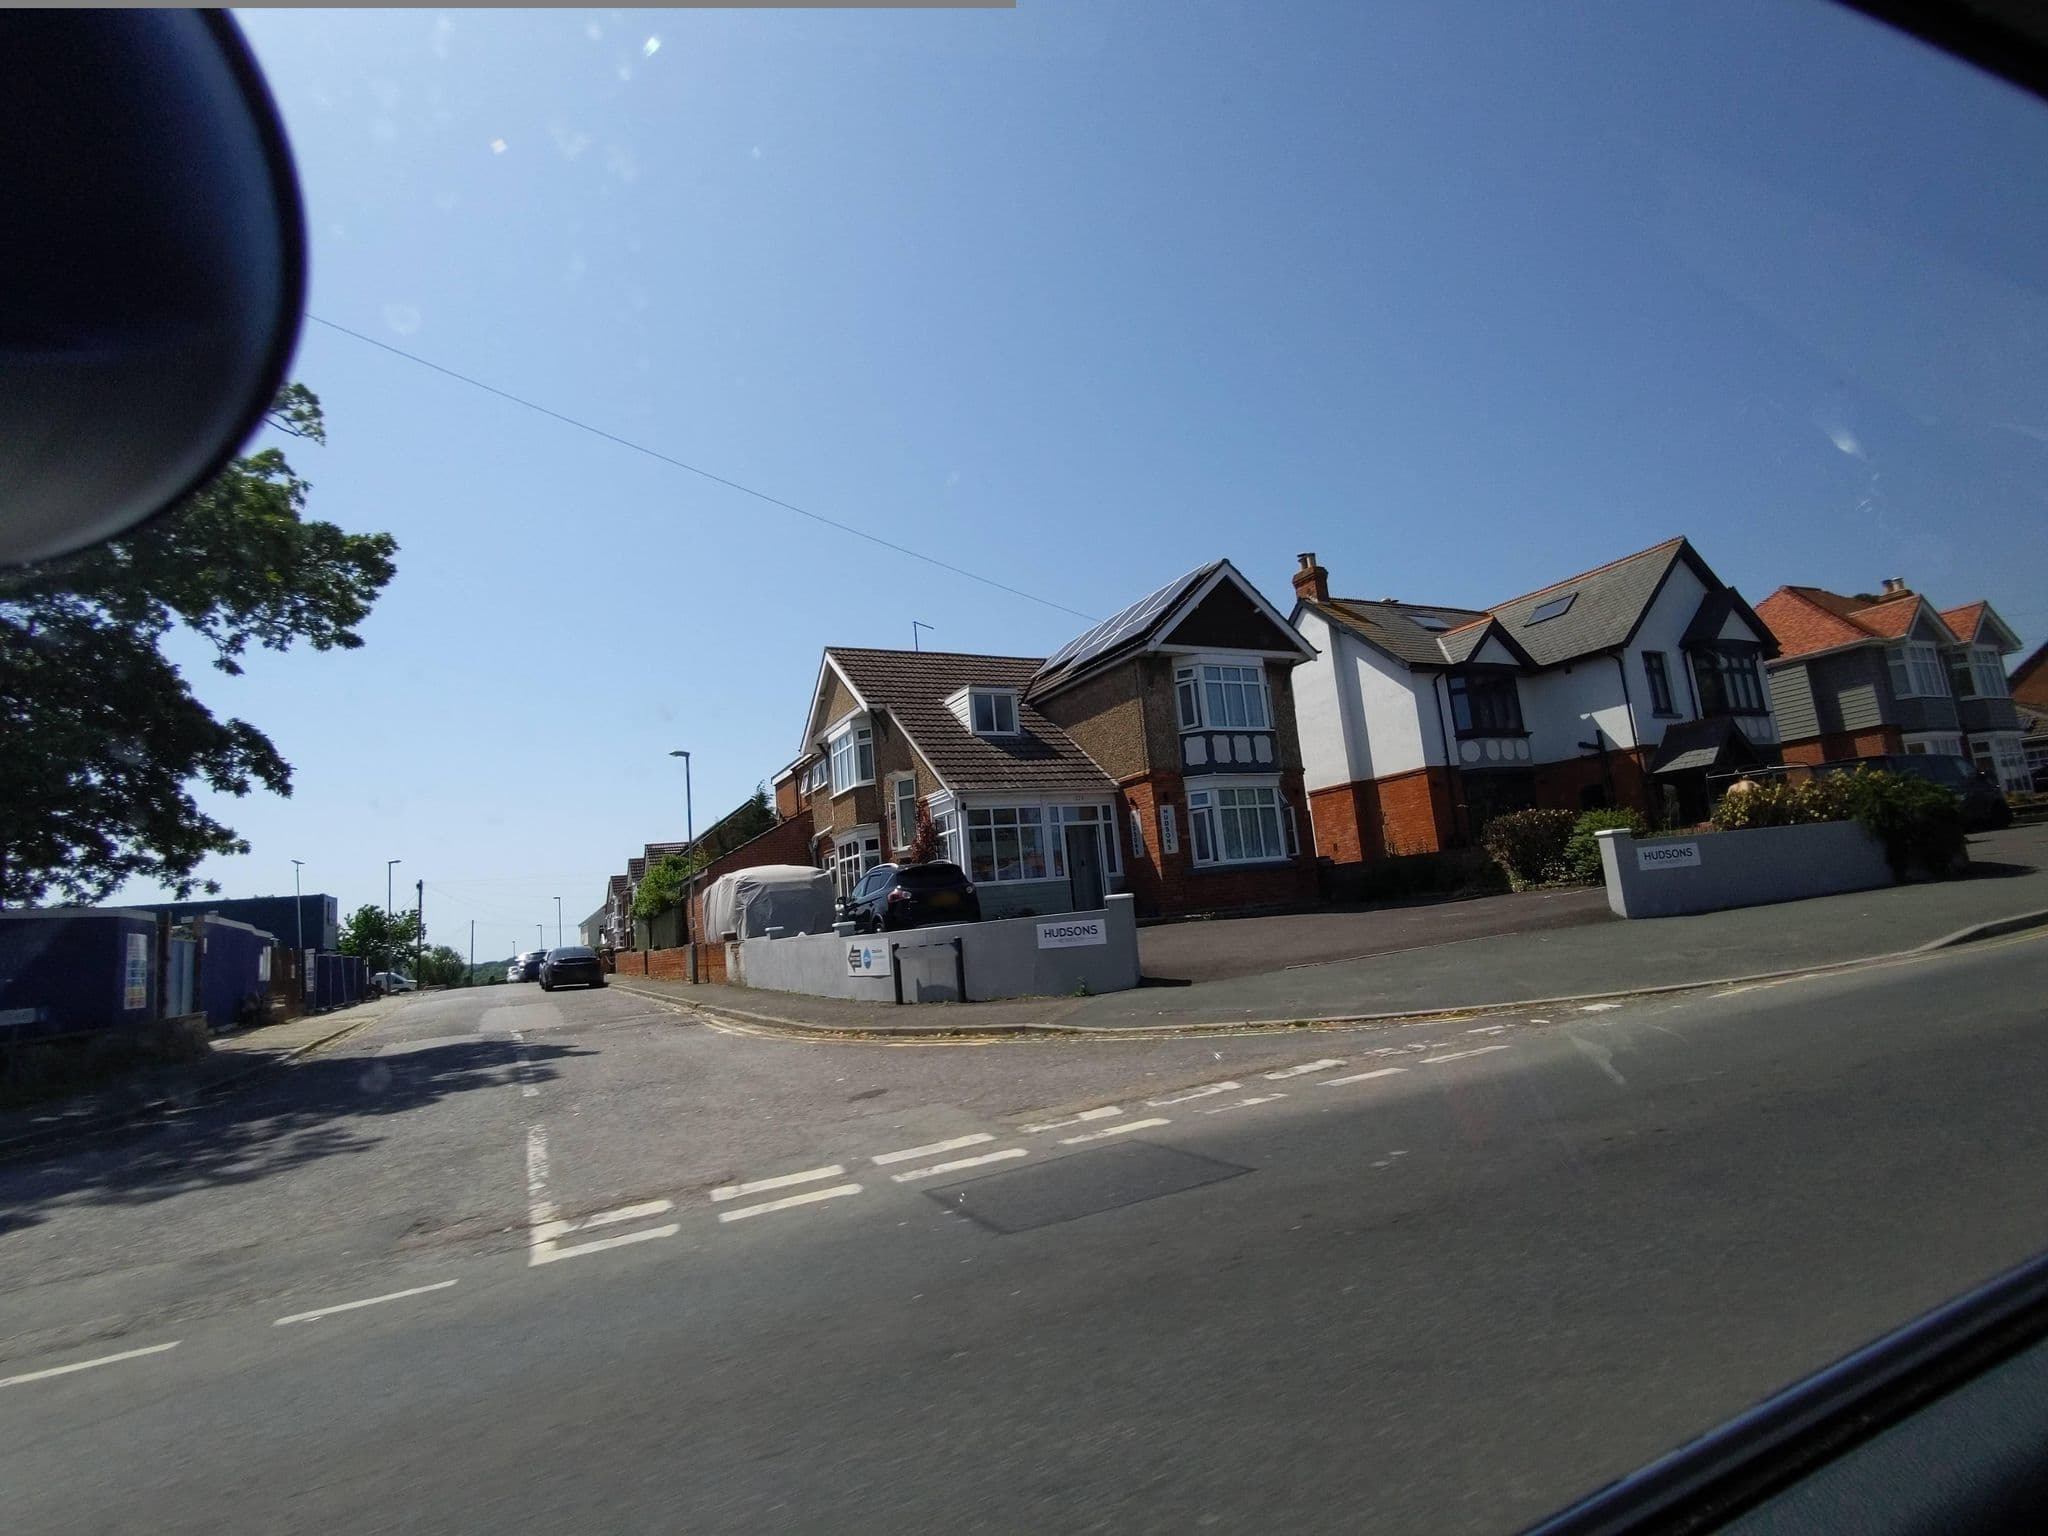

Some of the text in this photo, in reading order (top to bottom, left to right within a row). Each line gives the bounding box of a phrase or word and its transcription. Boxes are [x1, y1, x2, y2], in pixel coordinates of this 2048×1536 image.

[1163, 807, 1172, 850] HUDSONS
[1643, 848, 1693, 860] HUDSONS
[1044, 925, 1098, 938] HUDSONS
